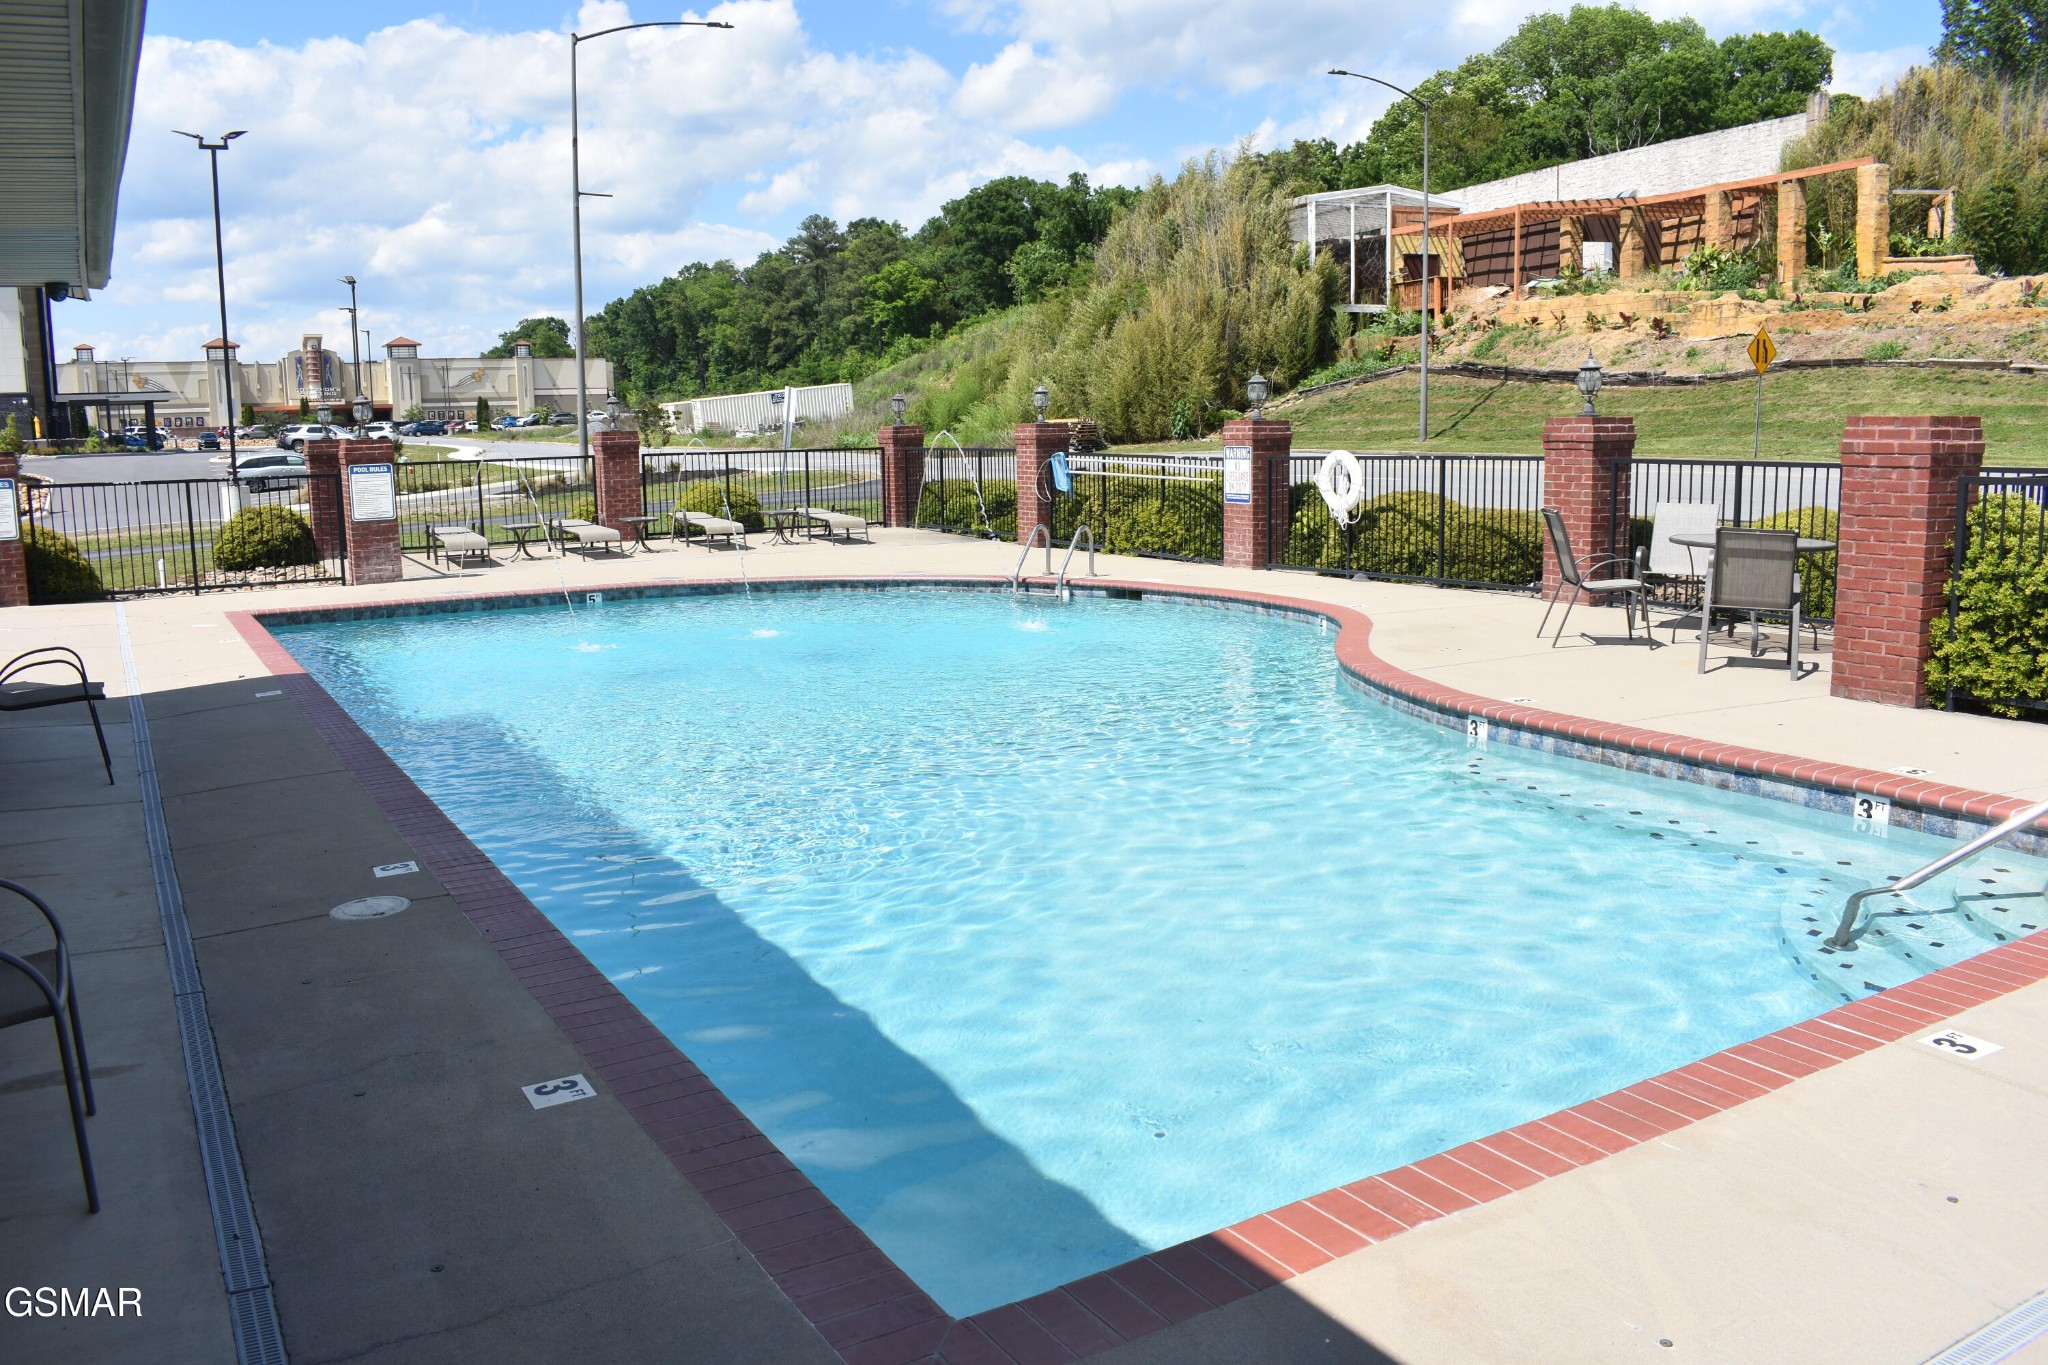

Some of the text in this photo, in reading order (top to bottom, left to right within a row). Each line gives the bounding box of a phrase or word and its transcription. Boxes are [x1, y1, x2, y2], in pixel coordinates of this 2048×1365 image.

[1225, 448, 1250, 459] WARNING
[1469, 720, 1479, 736] 3
[1857, 799, 1887, 818] 3 FT
[1932, 1037, 1978, 1055] 3
[533, 1080, 579, 1096] 3
